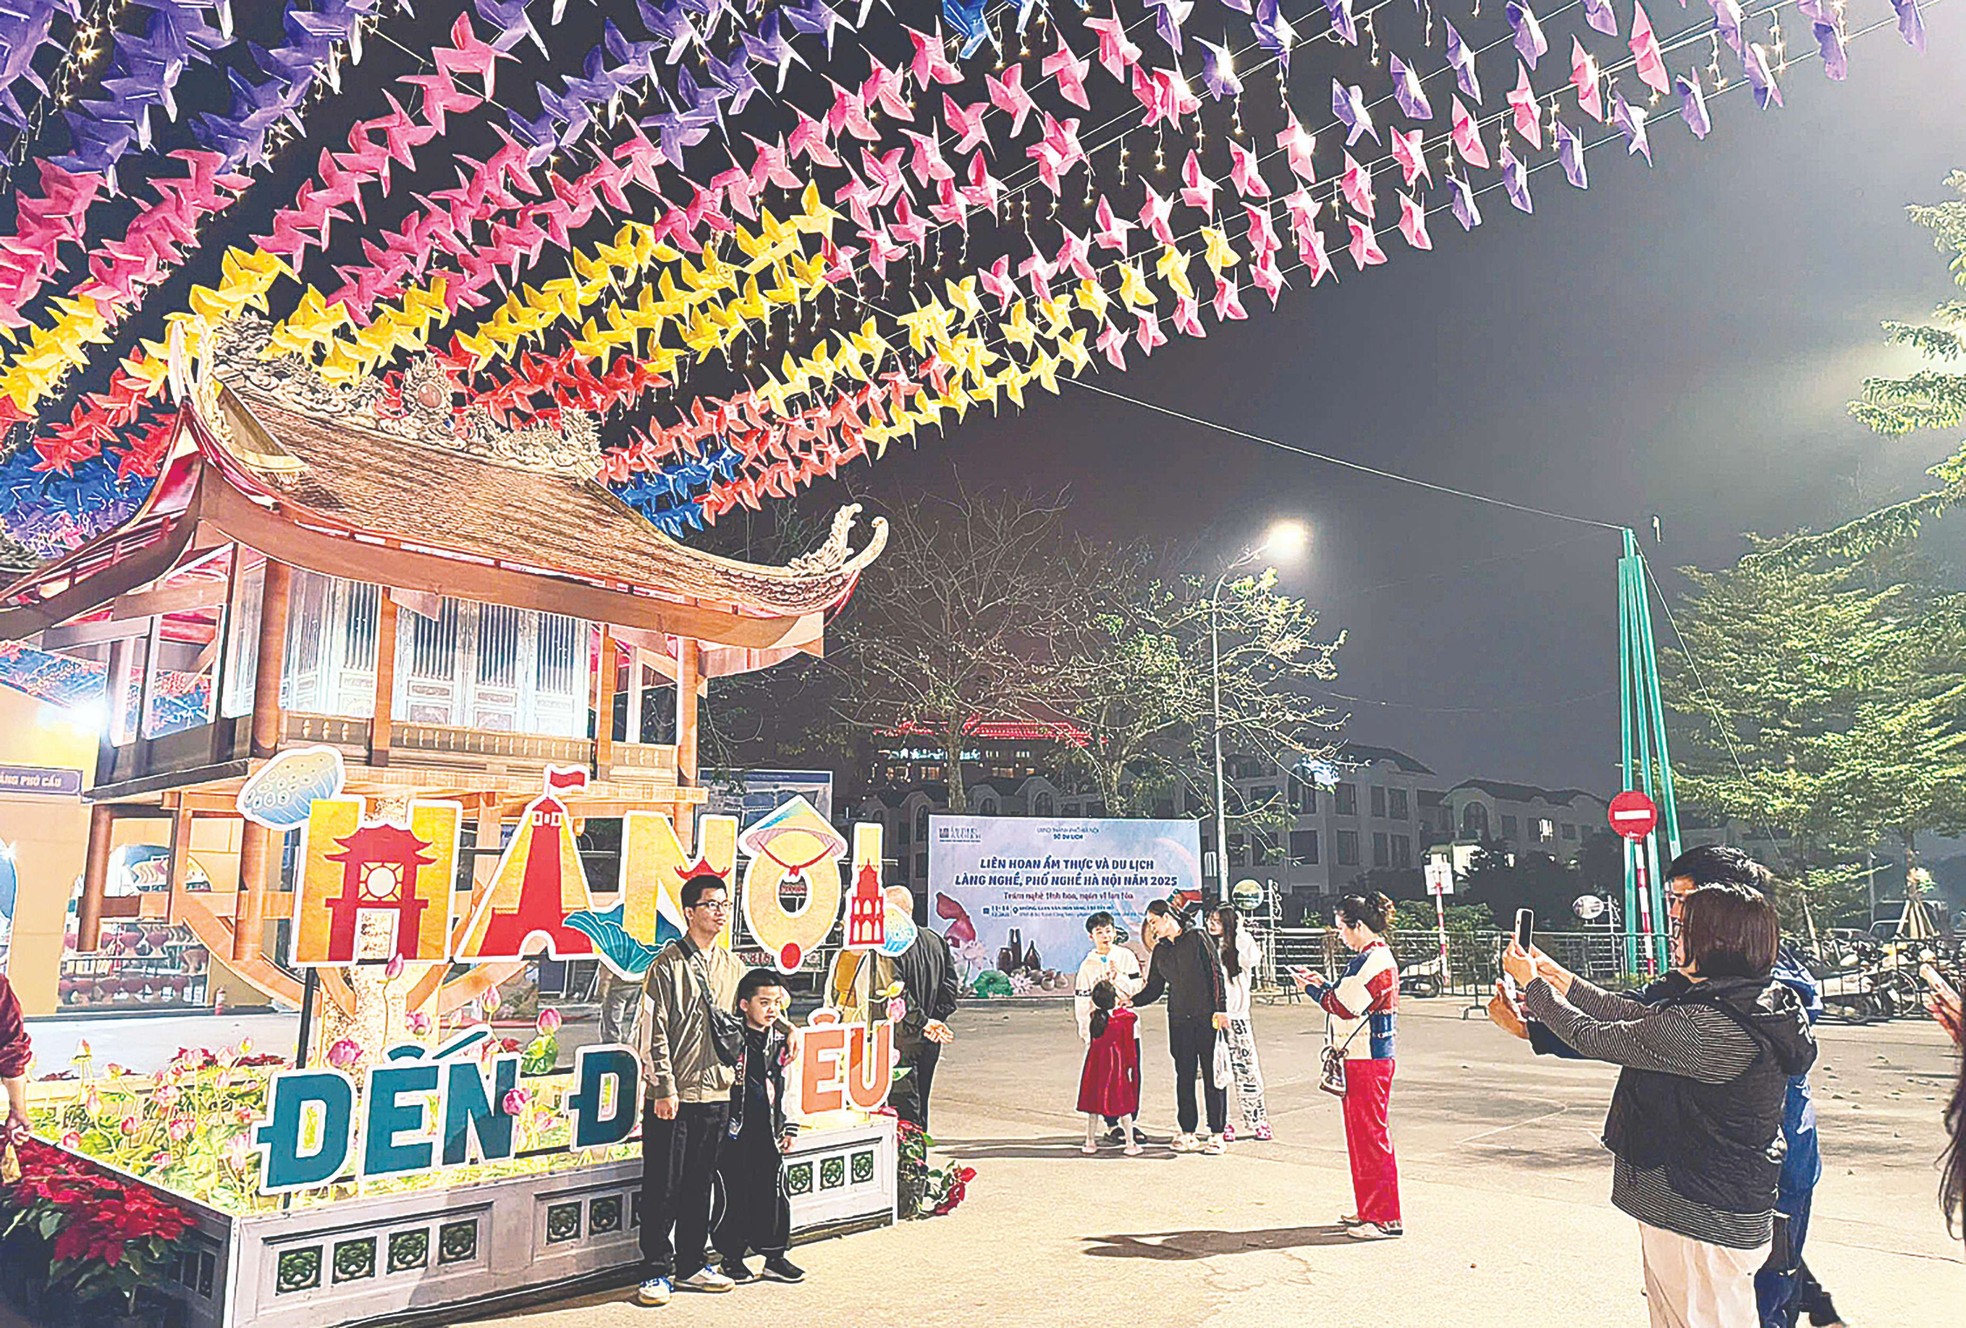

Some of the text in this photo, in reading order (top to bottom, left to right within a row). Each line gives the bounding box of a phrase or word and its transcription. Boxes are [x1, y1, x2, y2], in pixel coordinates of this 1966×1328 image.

[980, 856, 1006, 869] LIÊN
[1009, 859, 1041, 869] HOAN
[1063, 858, 1093, 871] THỰC
[1095, 857, 1109, 870] VÀ
[1112, 859, 1127, 870] DU
[1129, 859, 1154, 872] LỊCH
[955, 872, 986, 886] LÀNG
[1025, 871, 1050, 886] PHỐ
[1083, 873, 1099, 886] HÀ
[1101, 873, 1121, 888] NỘI
[1124, 873, 1148, 886] NĂM
[1150, 876, 1178, 886] 2025
[256, 1028, 521, 1190] ĐẾN
